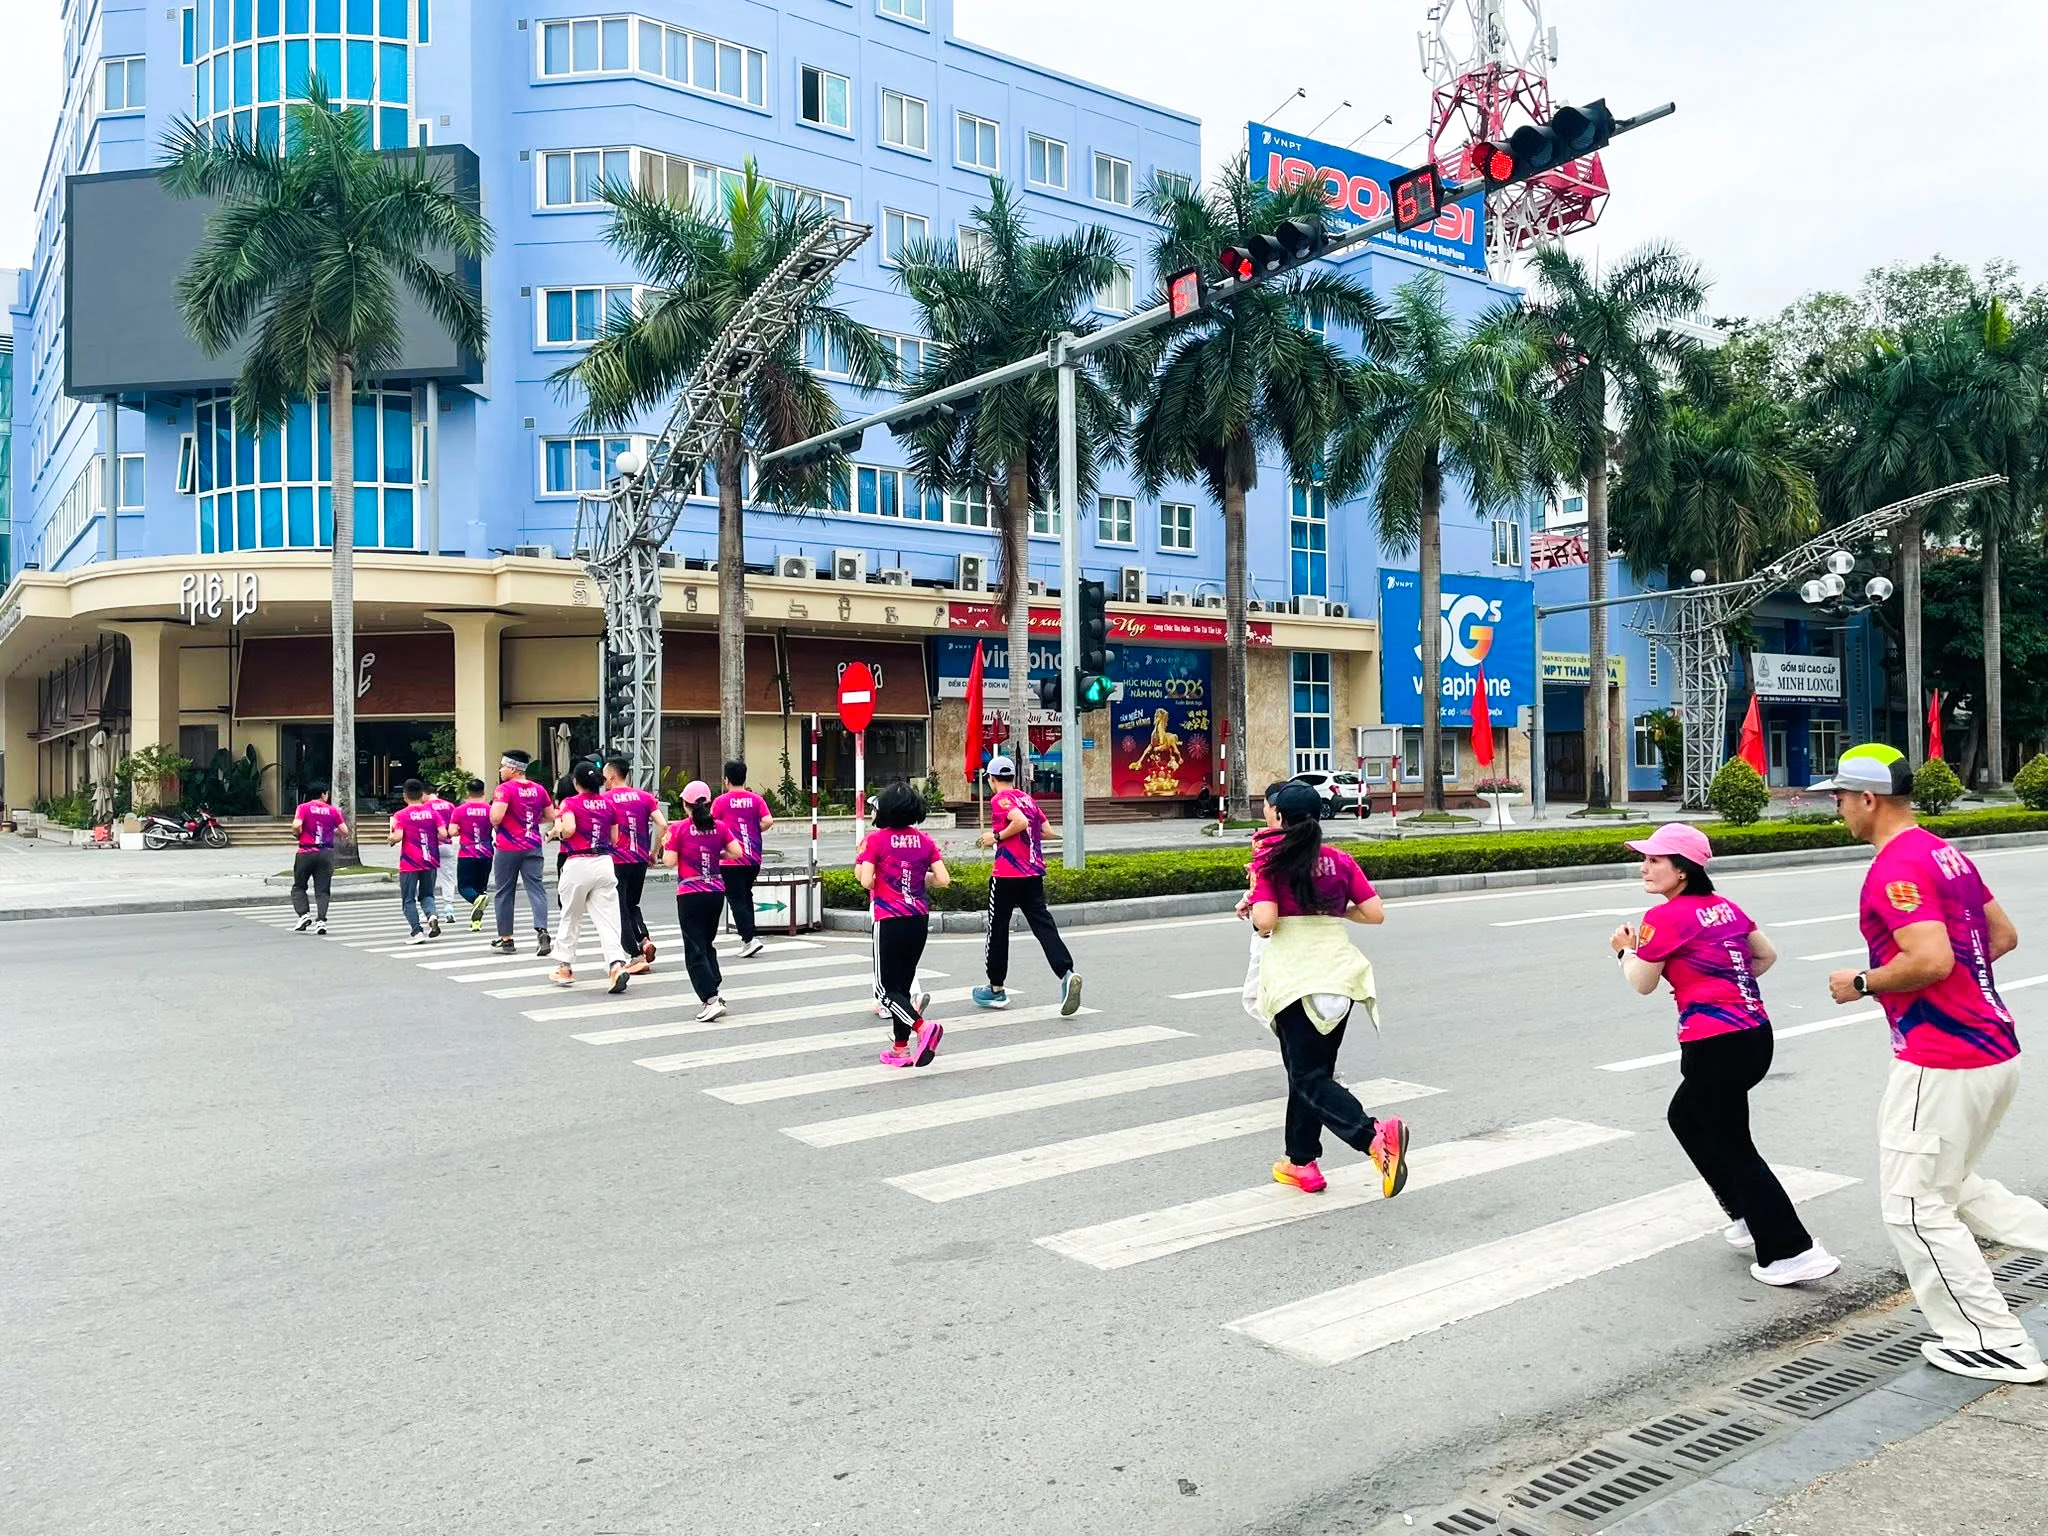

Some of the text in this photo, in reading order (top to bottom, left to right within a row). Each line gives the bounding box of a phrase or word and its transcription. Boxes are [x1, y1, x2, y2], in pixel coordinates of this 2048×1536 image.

[1274, 137, 1301, 151] VNPT
[1397, 173, 1436, 223] 67
[1780, 661, 1796, 672] GỐM
[1798, 662, 1807, 672] SỨ
[1823, 664, 1836, 674] CẤP
[1140, 678, 1162, 688] MỪNG
[1164, 678, 1204, 699] 2026
[1777, 677, 1804, 691] MINH
[1807, 678, 1834, 692] LONG
[1130, 689, 1163, 698] NĂM MỚI
